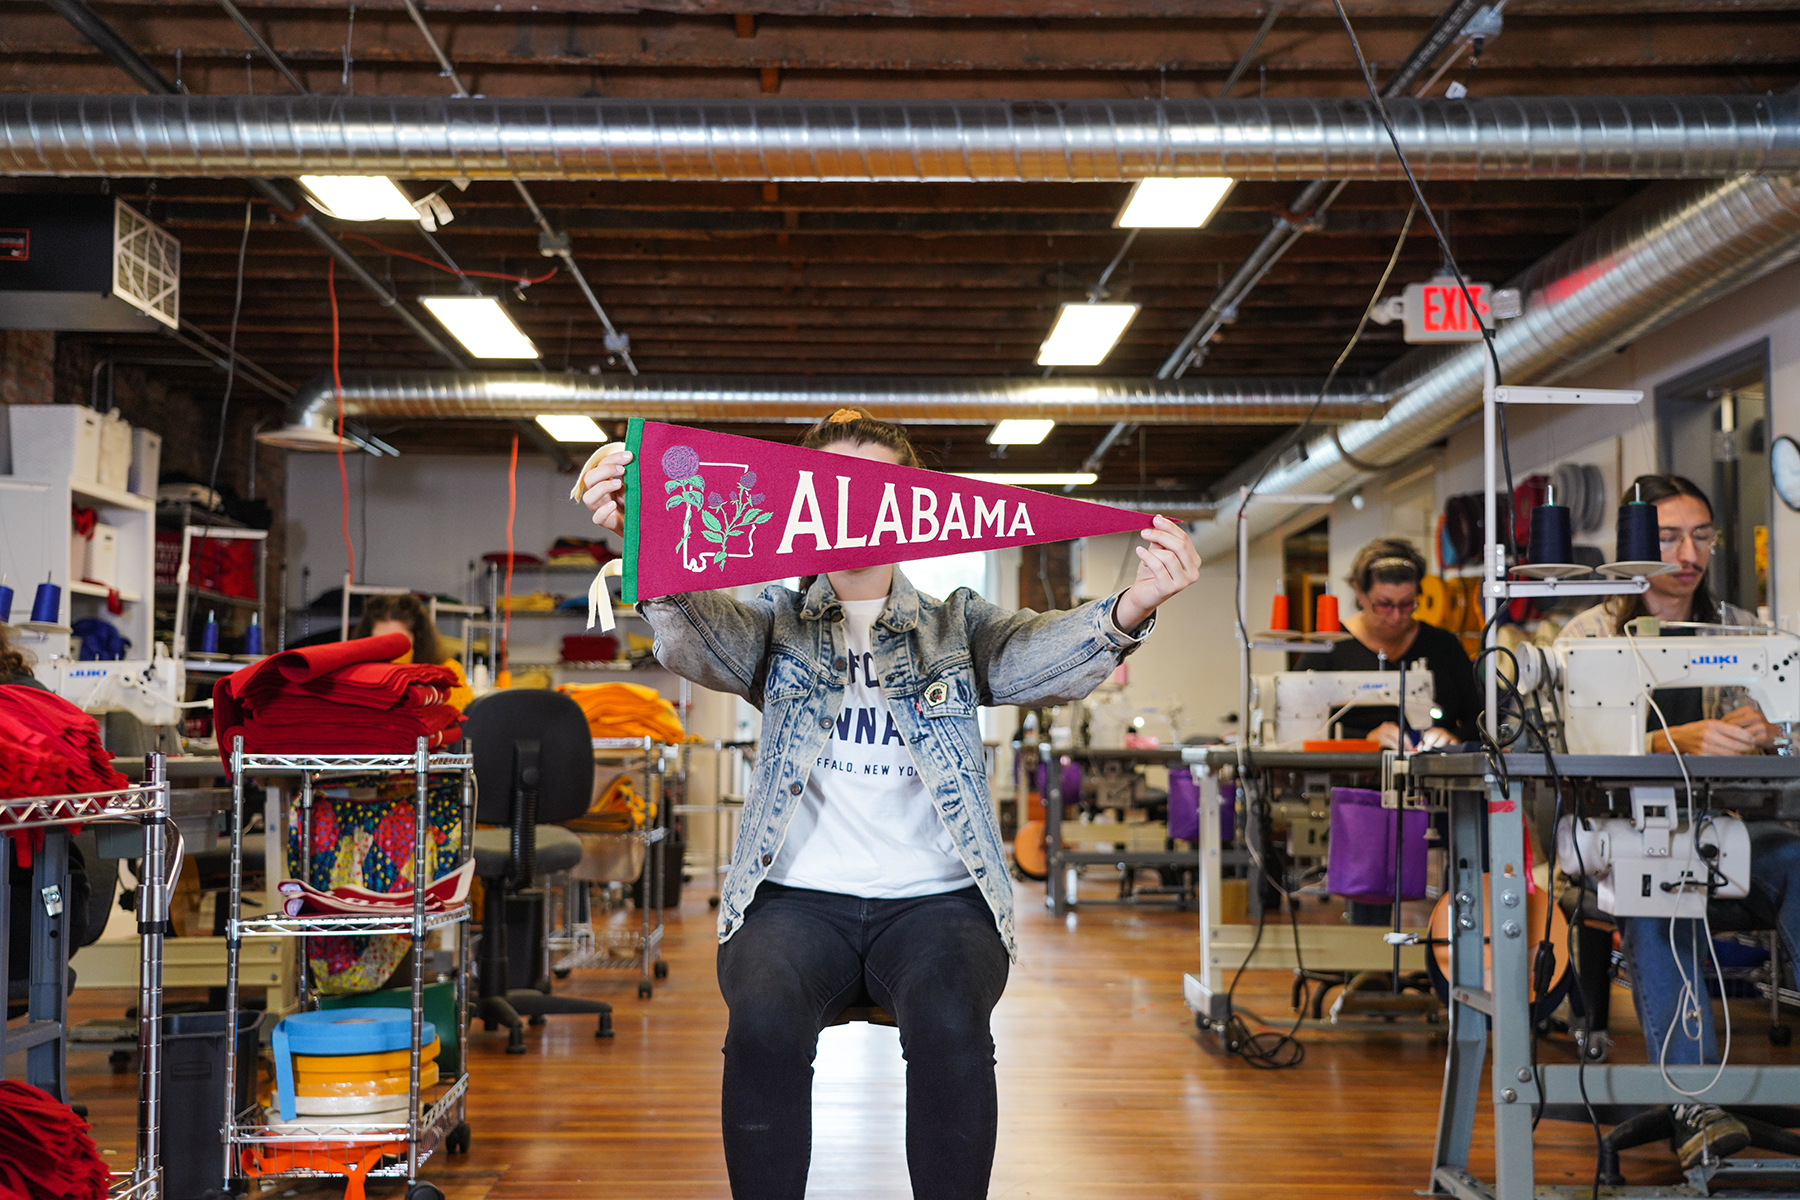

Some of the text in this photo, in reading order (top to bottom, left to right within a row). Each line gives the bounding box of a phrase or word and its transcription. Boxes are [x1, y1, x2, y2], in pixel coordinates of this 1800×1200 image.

[1422, 285, 1484, 332] EXIT
[776, 470, 1036, 554] ALABAMA
[1691, 655, 1738, 665] JUKI
[864, 764, 890, 776] NEW
